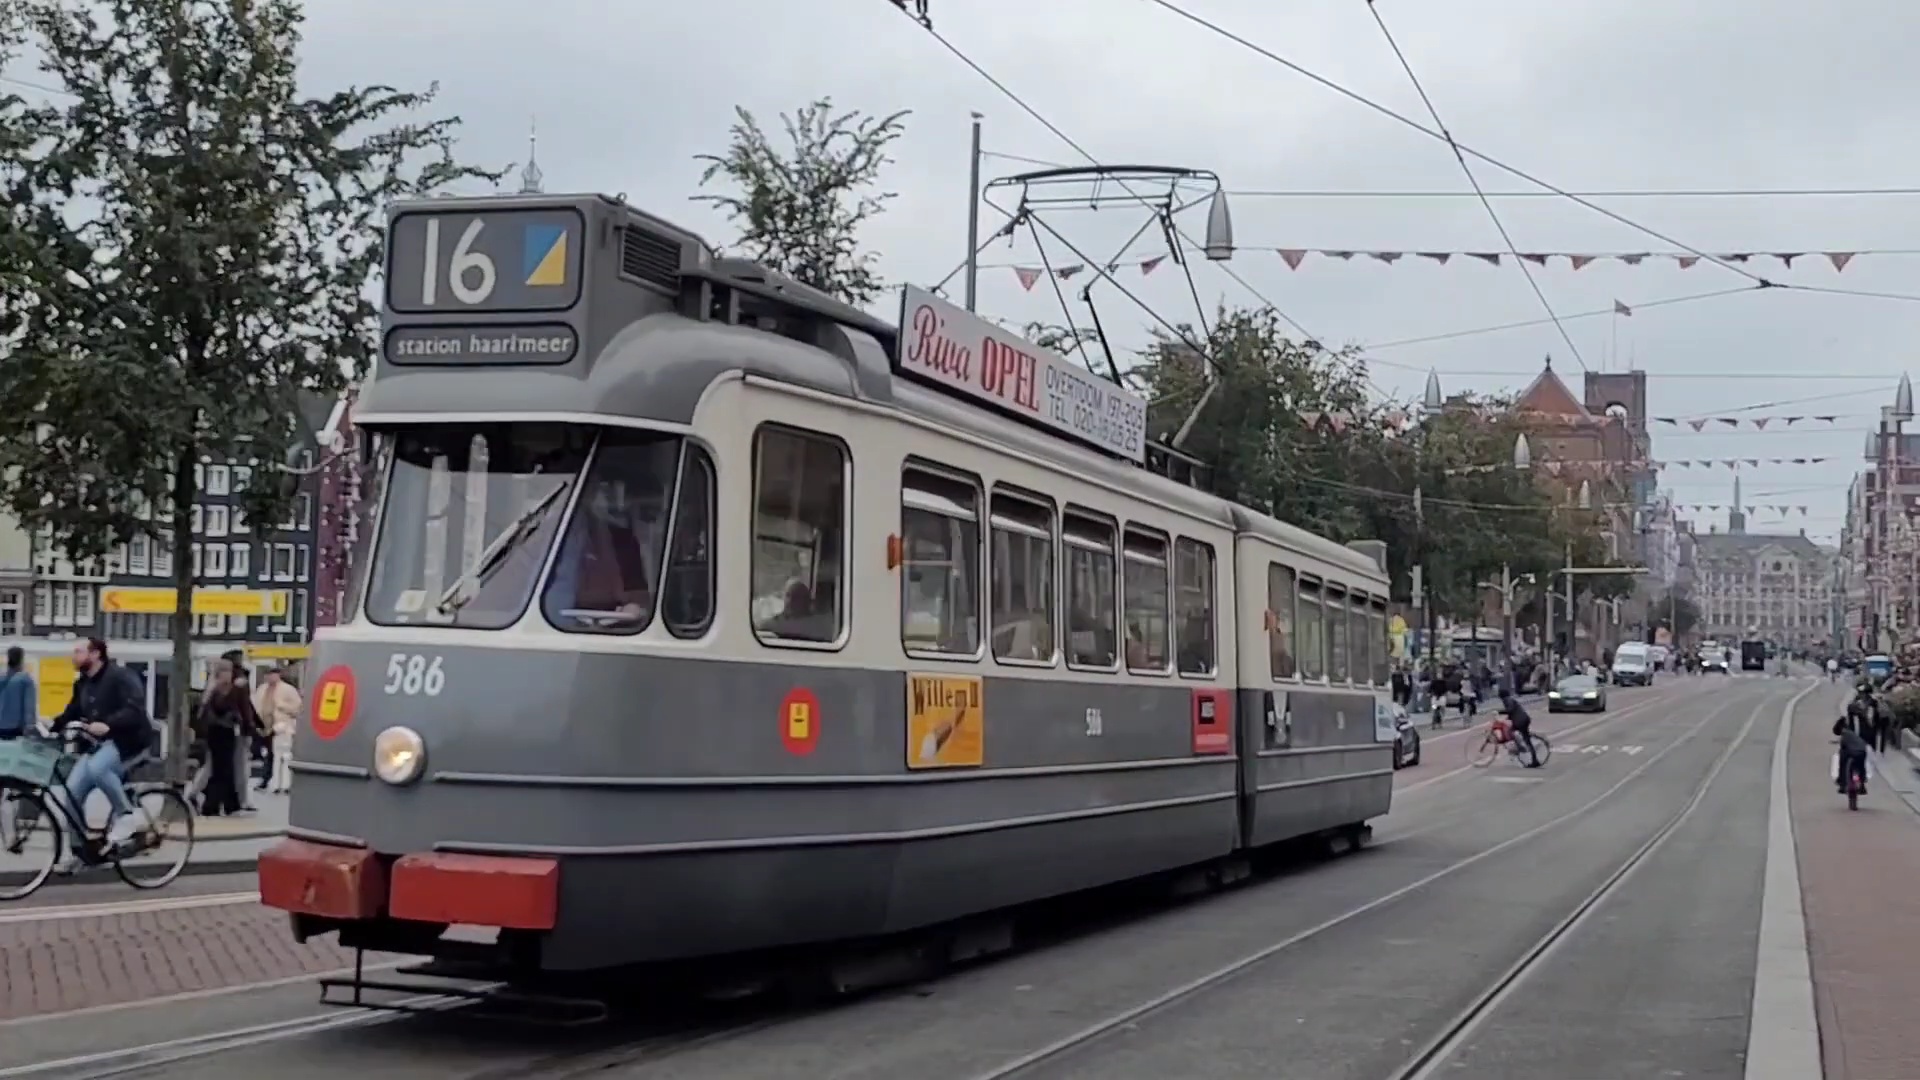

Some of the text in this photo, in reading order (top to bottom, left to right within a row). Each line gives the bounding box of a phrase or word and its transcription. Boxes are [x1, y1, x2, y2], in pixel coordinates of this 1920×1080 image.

[423, 218, 496, 305] 16
[397, 336, 461, 355] station
[908, 304, 1039, 412] Riva OPEL
[1046, 364, 1102, 410] OVERTOOM
[384, 654, 445, 696] 586
[912, 678, 967, 715] Willem
